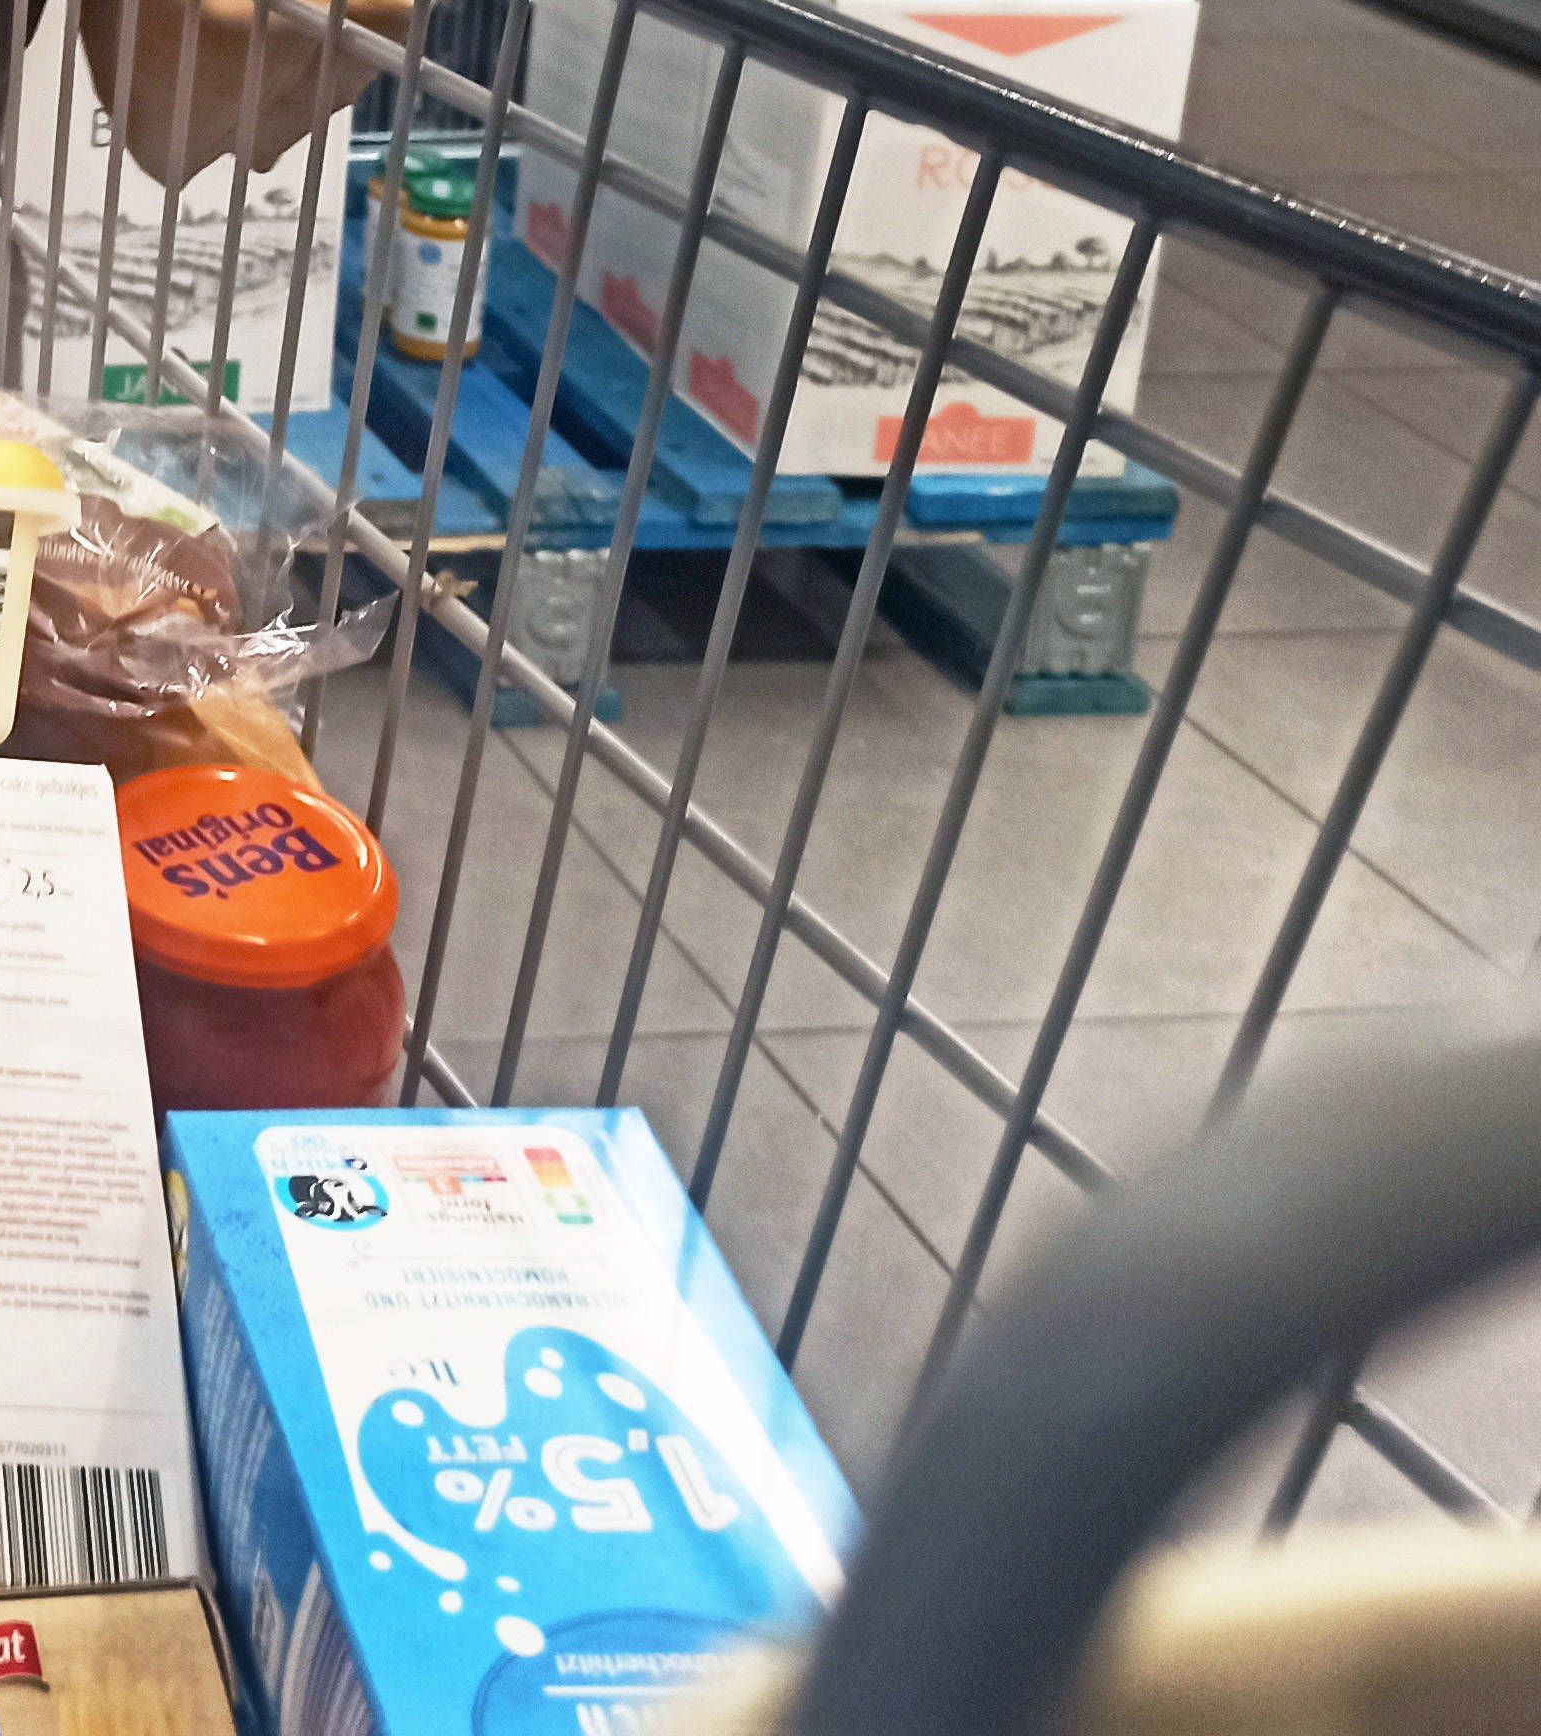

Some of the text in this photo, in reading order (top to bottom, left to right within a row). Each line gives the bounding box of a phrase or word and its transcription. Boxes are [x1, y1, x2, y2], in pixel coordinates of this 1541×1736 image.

[131, 801, 294, 868] Original
[20, 867, 57, 898] 2,5
[162, 825, 342, 902] Ben's
[425, 1433, 531, 1465] FETT
